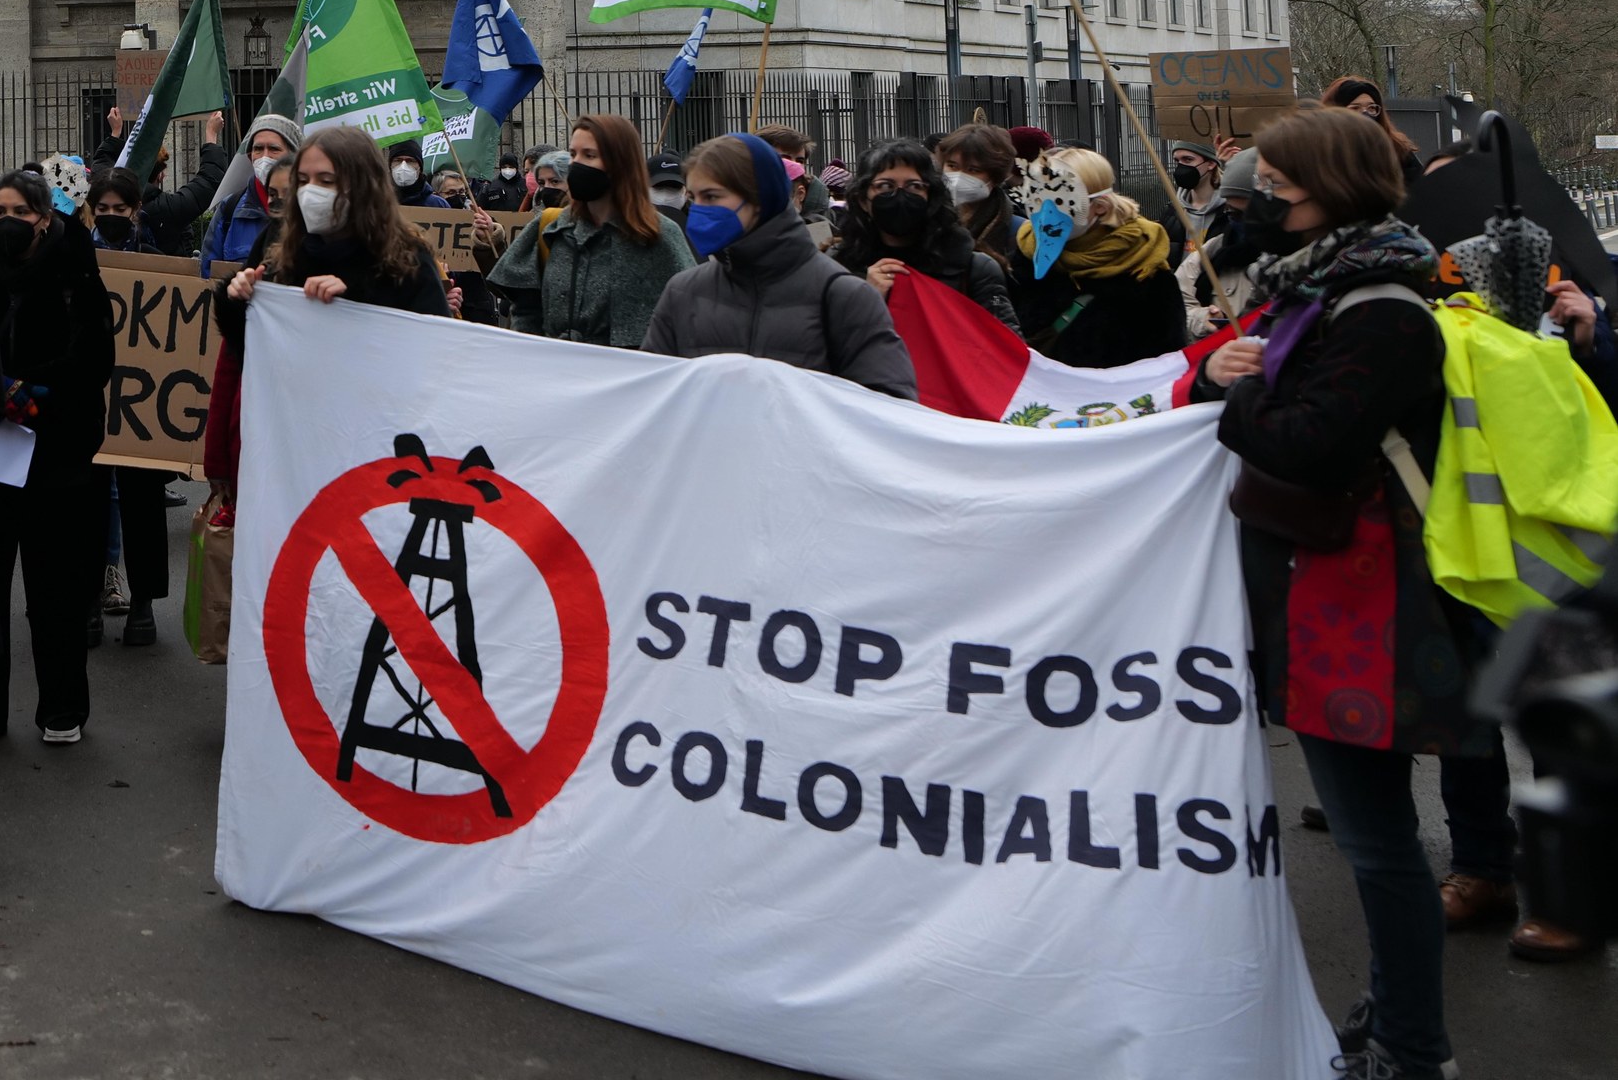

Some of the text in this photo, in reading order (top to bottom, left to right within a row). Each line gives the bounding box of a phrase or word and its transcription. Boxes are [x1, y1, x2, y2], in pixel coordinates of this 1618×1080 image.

[117, 73, 157, 86] DEPRE
[1160, 50, 1285, 88] OCEANS
[1197, 89, 1230, 101] OVER
[1190, 105, 1252, 137] OIL
[636, 591, 1266, 729] STOP FOSS
[611, 721, 1281, 878] COLONIALISM
